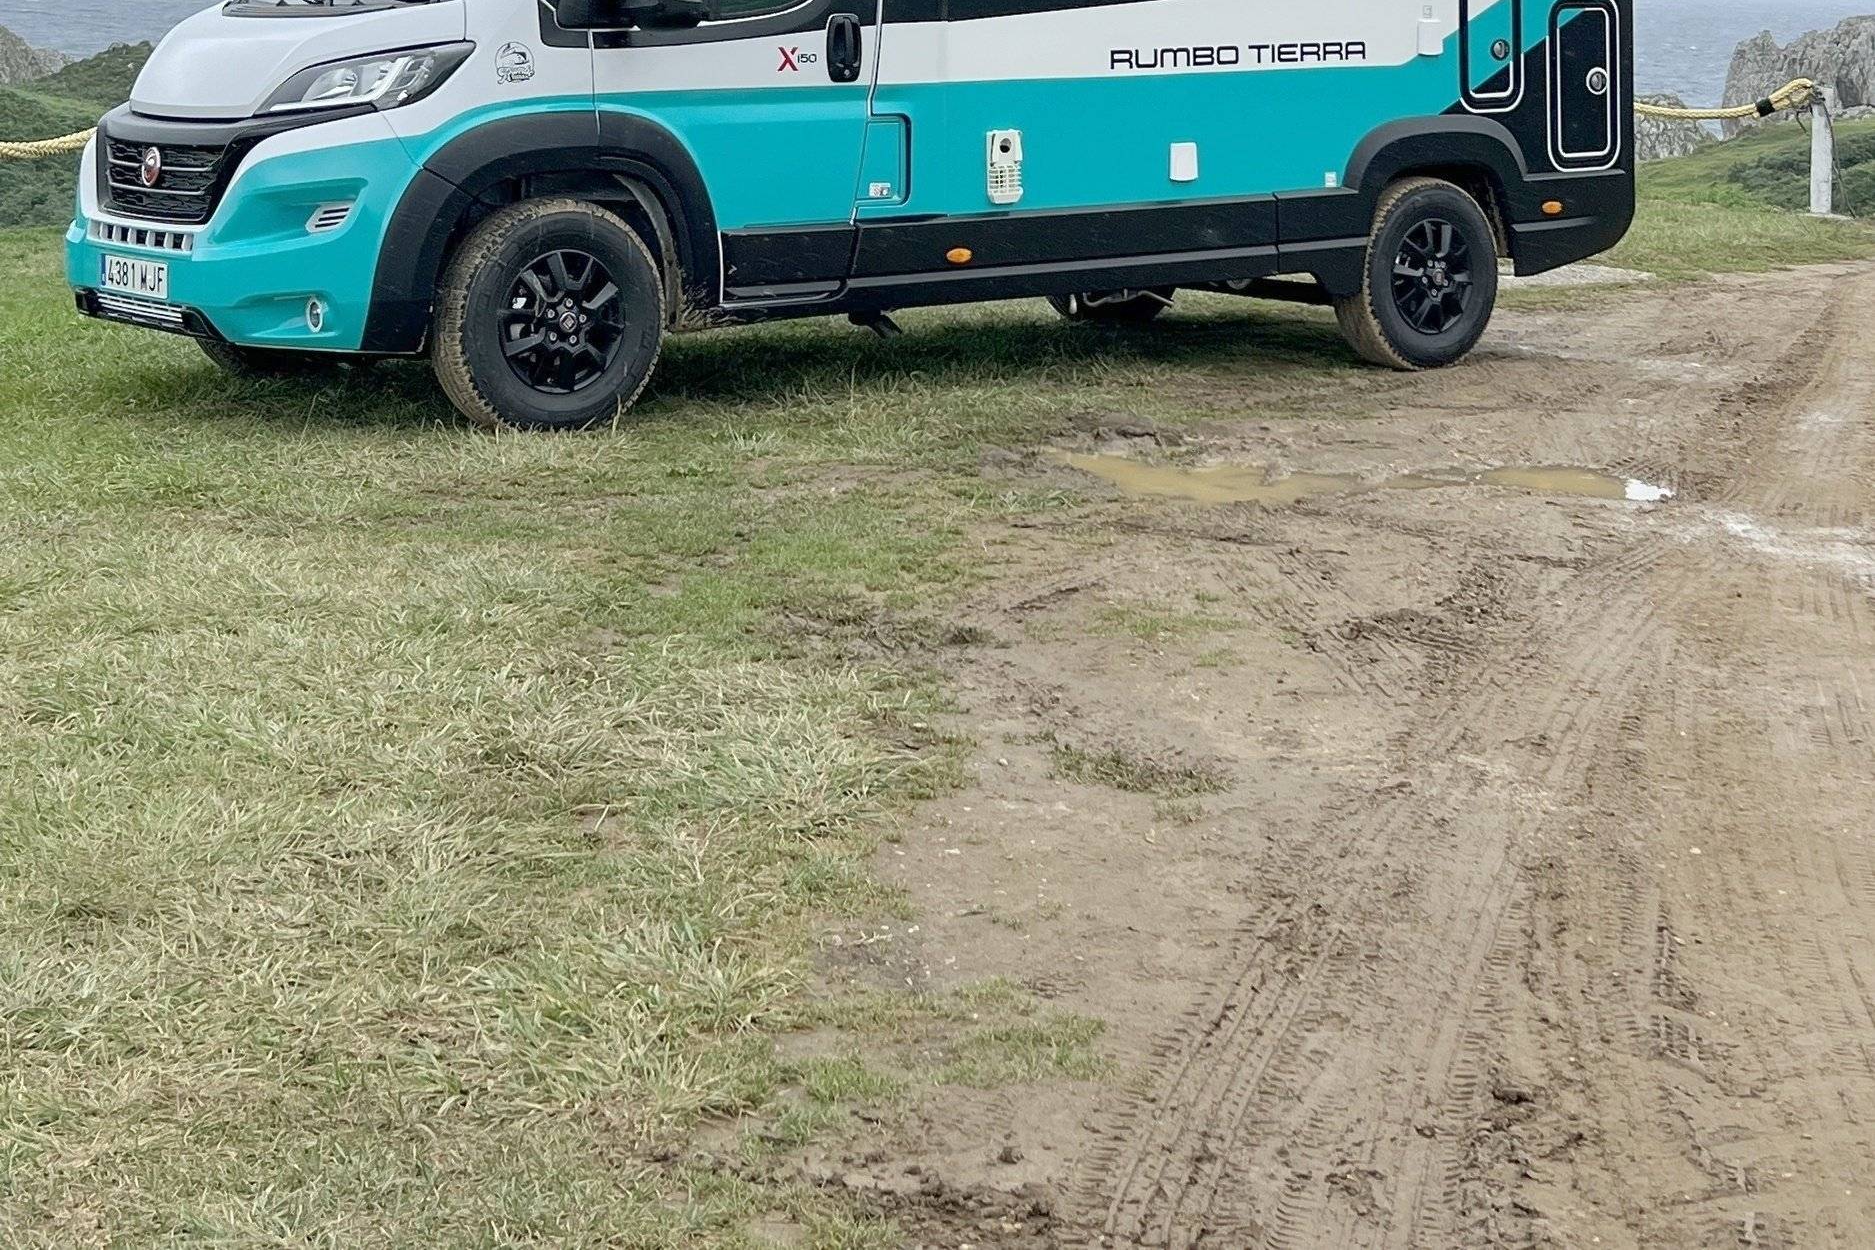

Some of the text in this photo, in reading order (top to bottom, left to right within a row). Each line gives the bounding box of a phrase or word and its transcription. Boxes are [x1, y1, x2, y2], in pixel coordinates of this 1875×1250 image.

[1110, 41, 1367, 70] RUMBO TIERRA
[108, 259, 165, 293] 4381 MJF
